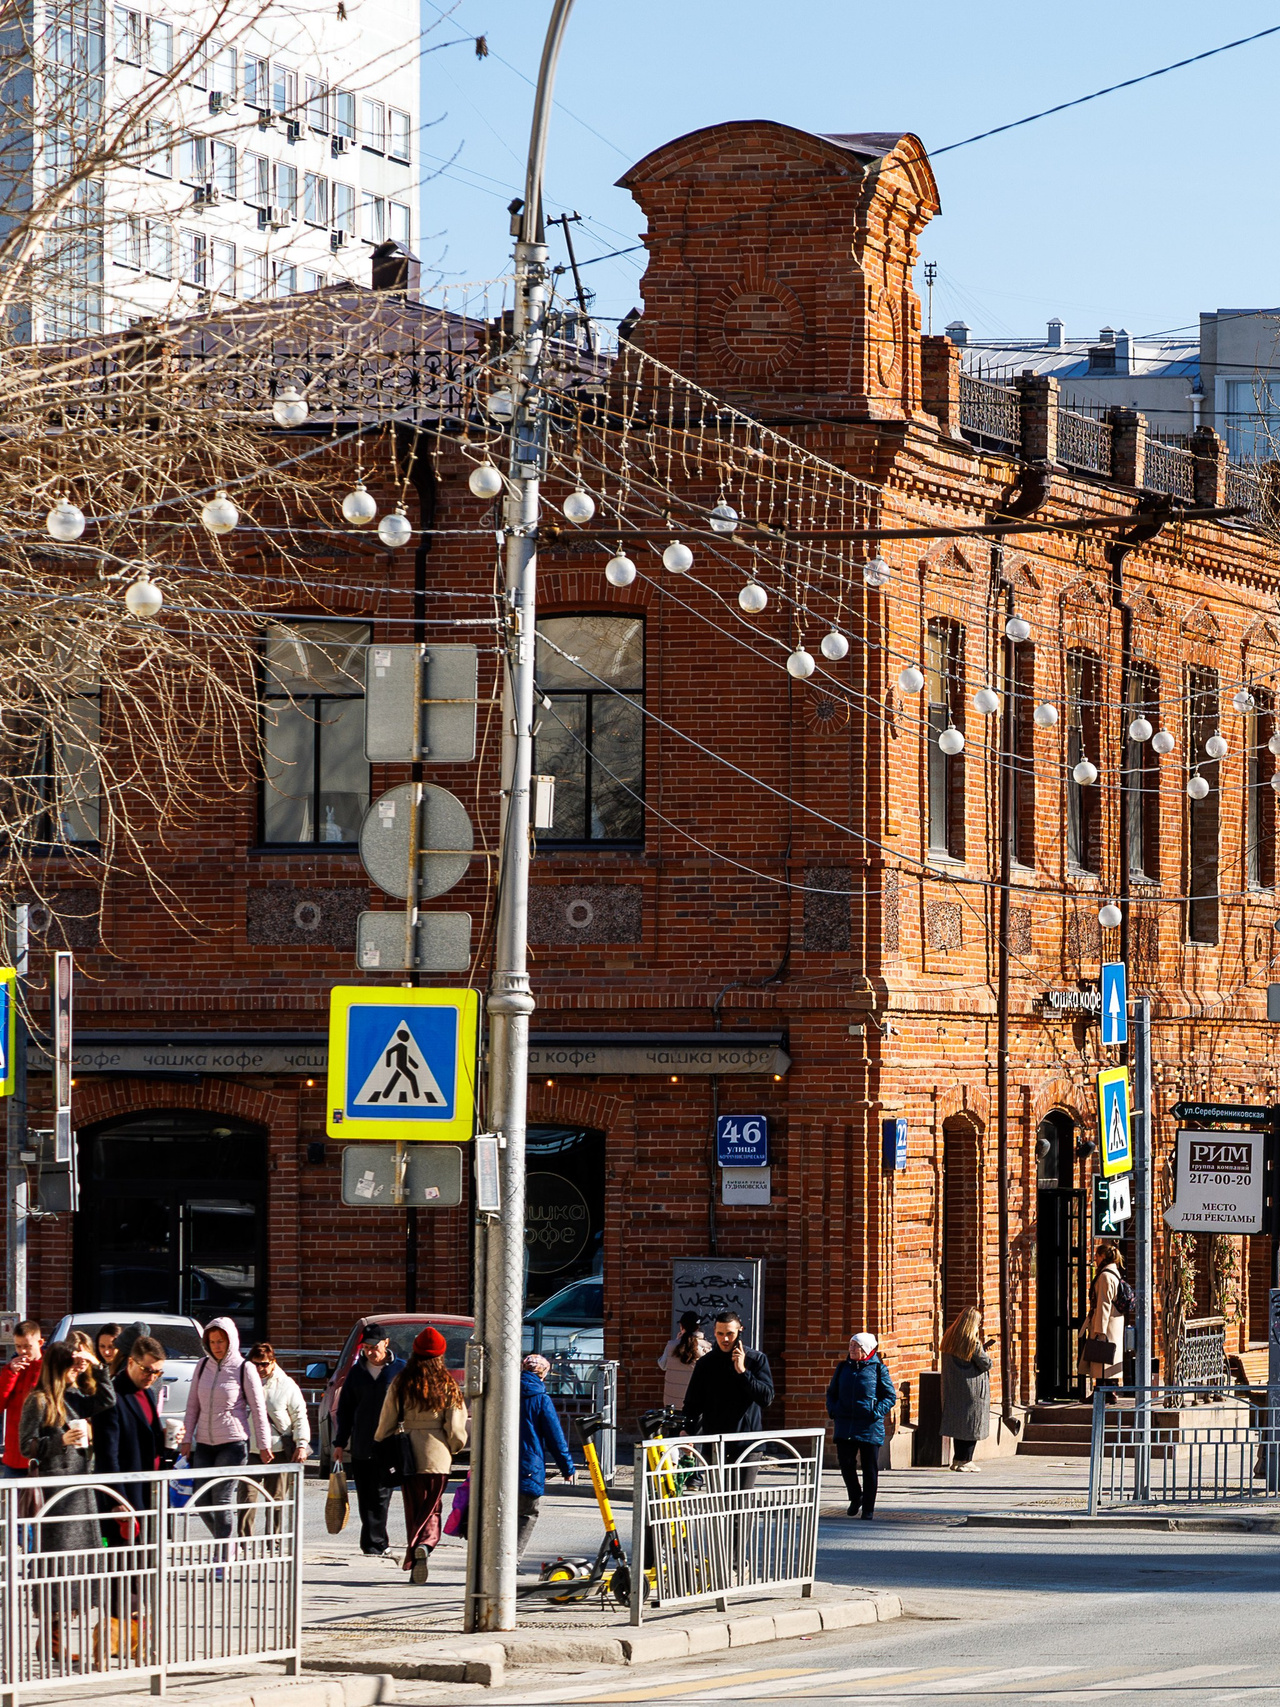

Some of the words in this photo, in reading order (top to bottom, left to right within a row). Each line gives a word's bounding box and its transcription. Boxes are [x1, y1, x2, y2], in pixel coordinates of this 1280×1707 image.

[1049, 991, 1079, 1009] чашка
[1079, 985, 1101, 1016] кофе
[143, 1053, 207, 1067] чашка
[212, 1051, 263, 1071] кофе
[284, 1053, 328, 1067] чаш
[545, 1048, 596, 1068] кофе
[646, 1050, 712, 1065] чашка
[718, 1049, 770, 1068] кофе
[722, 1120, 761, 1143] 46
[727, 1146, 757, 1154] улица
[1192, 1144, 1248, 1163] РИМ
[1189, 1173, 1252, 1186] 217-00-20
[525, 1205, 586, 1220] шка
[1201, 1202, 1237, 1212] МЕСТО
[1181, 1212, 1203, 1222] ДЛЯ
[1204, 1213, 1256, 1224] РЕКЛАМЫ
